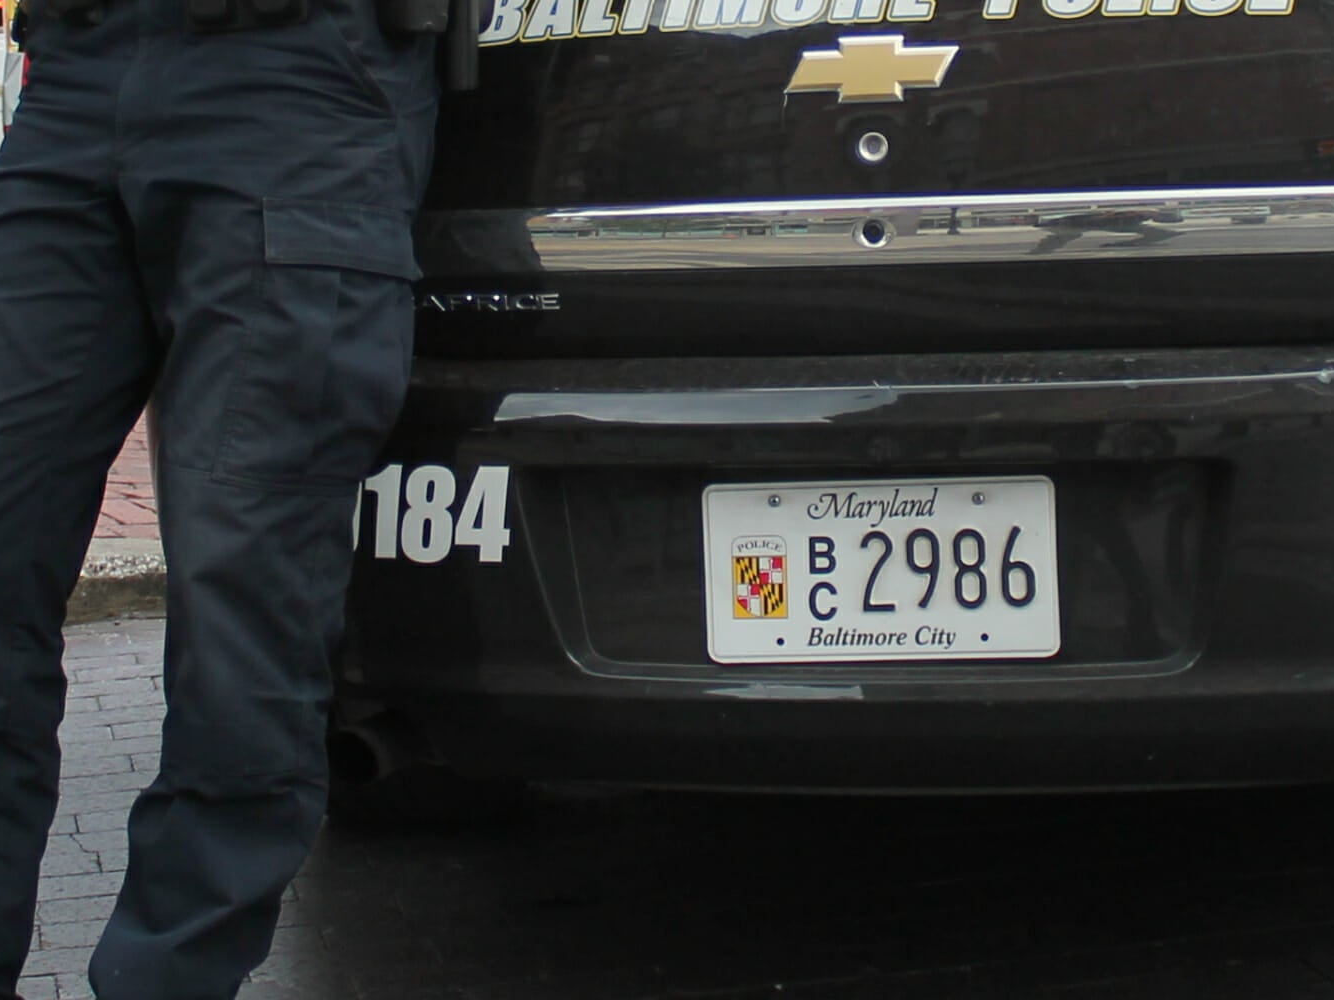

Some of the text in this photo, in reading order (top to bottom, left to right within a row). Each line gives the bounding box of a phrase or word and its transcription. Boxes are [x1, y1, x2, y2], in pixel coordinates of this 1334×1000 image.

[412, 292, 561, 312] APRICE
[352, 463, 511, 564] 184
[807, 487, 938, 528] Maryland
[736, 539, 784, 553] POLICE
[807, 535, 837, 575] B
[859, 524, 1037, 613] 2986
[807, 581, 839, 621] C
[807, 625, 957, 650] Baltimore City
